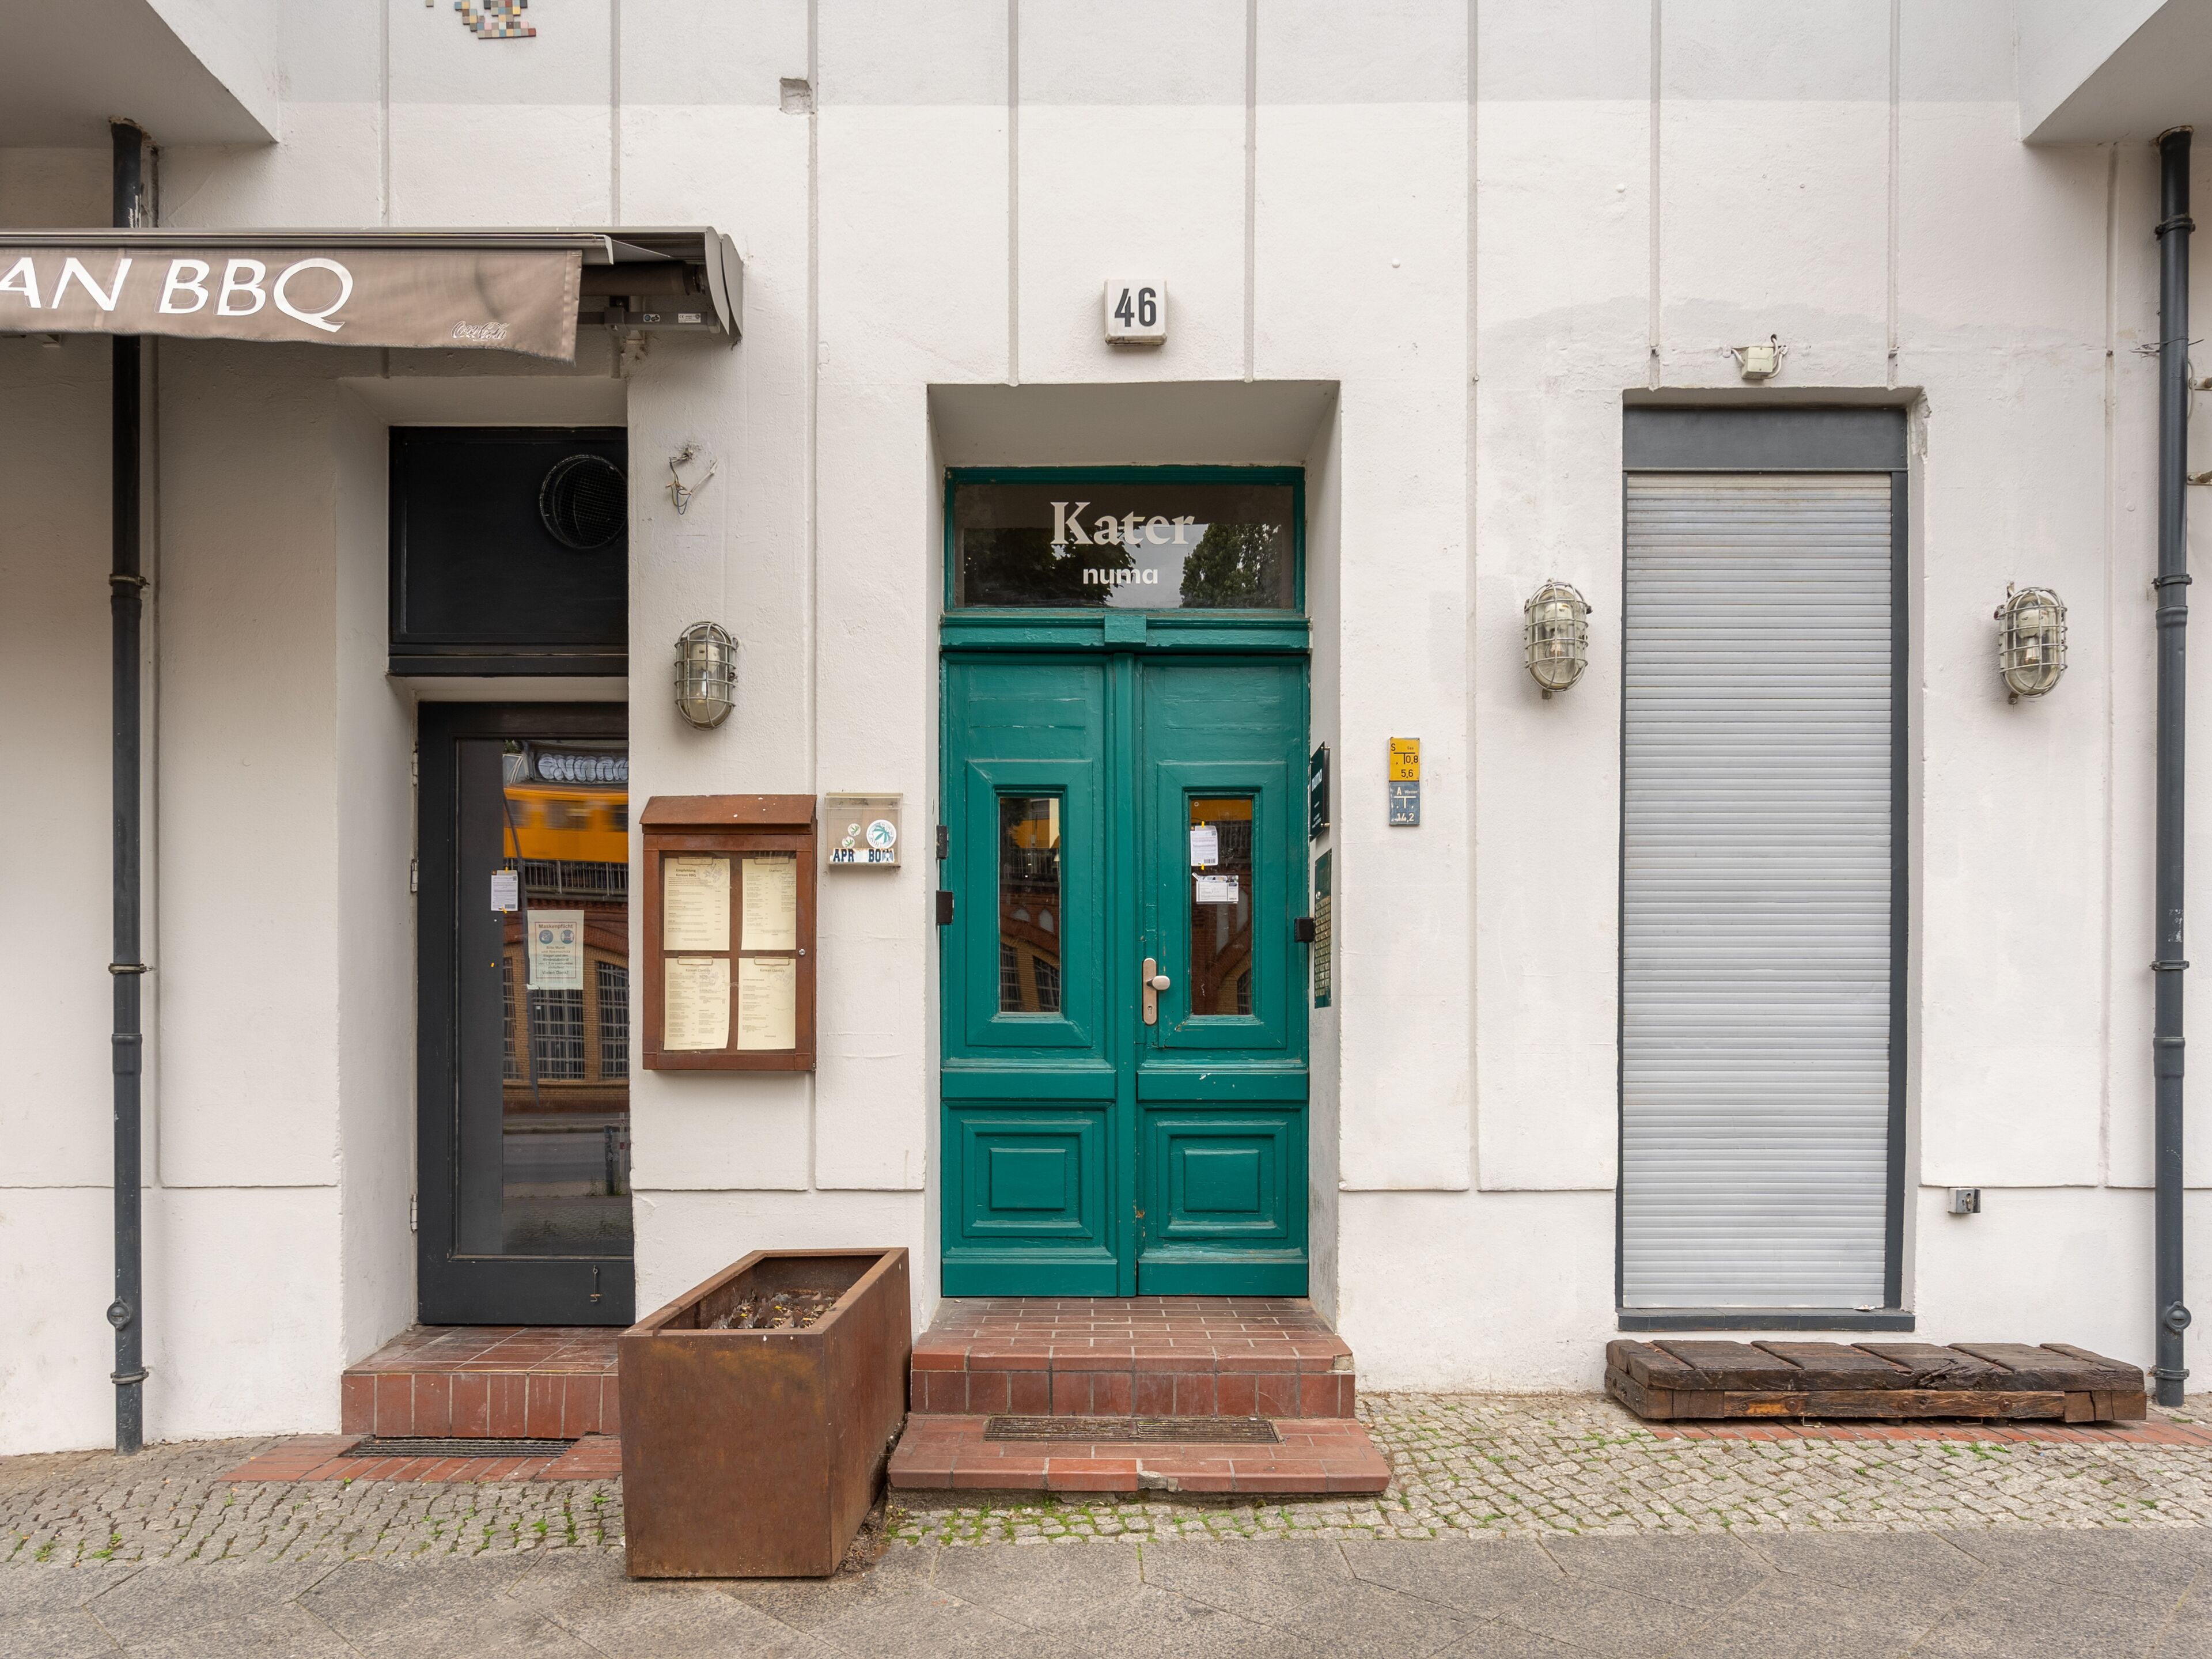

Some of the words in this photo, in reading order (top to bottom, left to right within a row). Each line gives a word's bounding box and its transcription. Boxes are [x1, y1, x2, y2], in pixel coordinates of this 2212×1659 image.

[0, 257, 132, 311] AN
[155, 257, 353, 332] BBQ
[1114, 287, 1157, 327] 46
[1050, 501, 1195, 546] Kater
[1083, 567, 1158, 585] numa
[1391, 743, 1396, 751] S
[1401, 769, 1414, 778] 5,6
[1397, 787, 1402, 795] A
[1397, 813, 1414, 823] 14,2
[833, 849, 854, 862] APR
